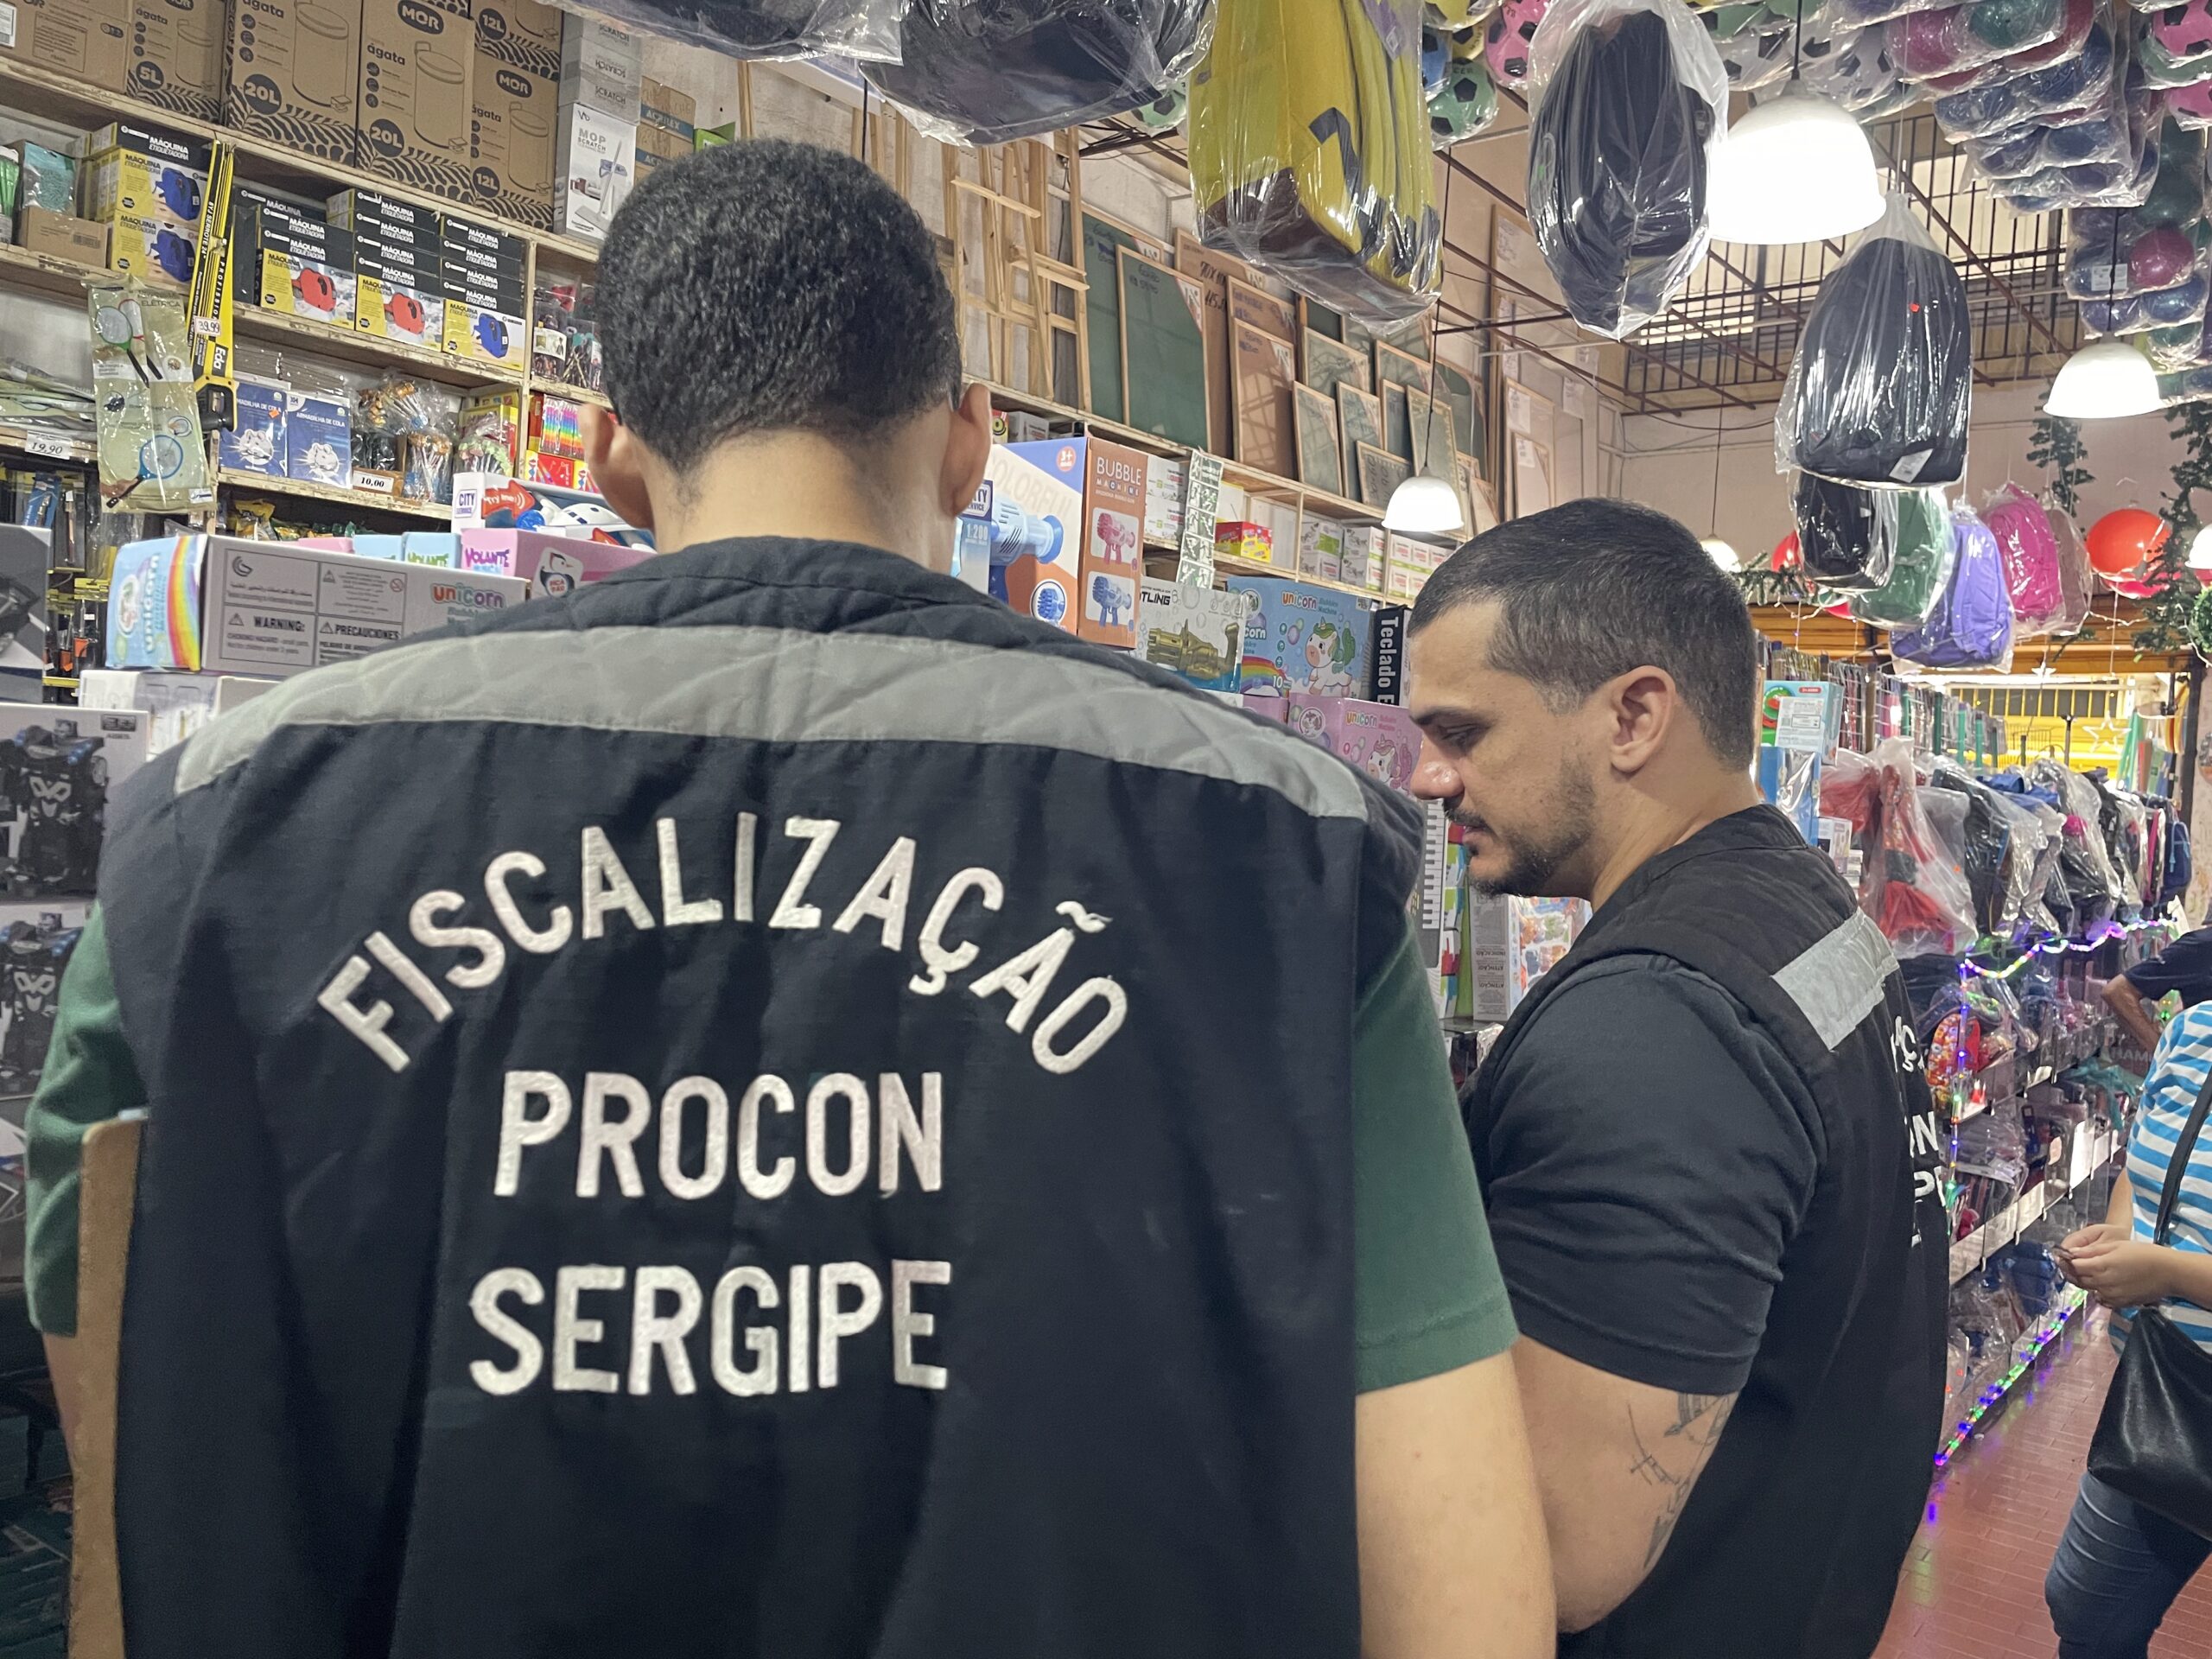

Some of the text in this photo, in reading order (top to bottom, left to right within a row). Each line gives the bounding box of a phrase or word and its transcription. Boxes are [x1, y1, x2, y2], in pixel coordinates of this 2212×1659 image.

[401, 4, 439, 30] MOR
[482, 14, 505, 33] 12L
[366, 42, 405, 66] ágata
[140, 66, 162, 86] 5L
[499, 74, 529, 95] MOR
[245, 82, 280, 106] 20L
[646, 110, 680, 130] ACRILEX
[370, 126, 402, 149] 20L
[578, 137, 606, 151] SCRATCH
[579, 128, 606, 143] MOP
[475, 173, 499, 191] 12L
[213, 261, 226, 321] PROFISSIO
[213, 346, 226, 370] Eda
[237, 398, 260, 409] MADILHA
[1096, 456, 1141, 486] BUBBLE
[1096, 478, 1139, 497] MACHINE
[459, 493, 475, 506] CITY
[465, 548, 510, 568] VOLANTE
[433, 583, 504, 609] unicorn
[1140, 591, 1172, 606] TLING
[1282, 591, 1317, 610] unicorn
[1244, 627, 1267, 640] corn
[1377, 616, 1399, 689] Teclado
[1273, 676, 1283, 689] 10
[1345, 711, 1377, 728] unicorn
[317, 811, 1128, 1074] FISCALIZAÇÃO
[493, 1071, 943, 1200] PROCON
[468, 1259, 951, 1396] SERGIPE
